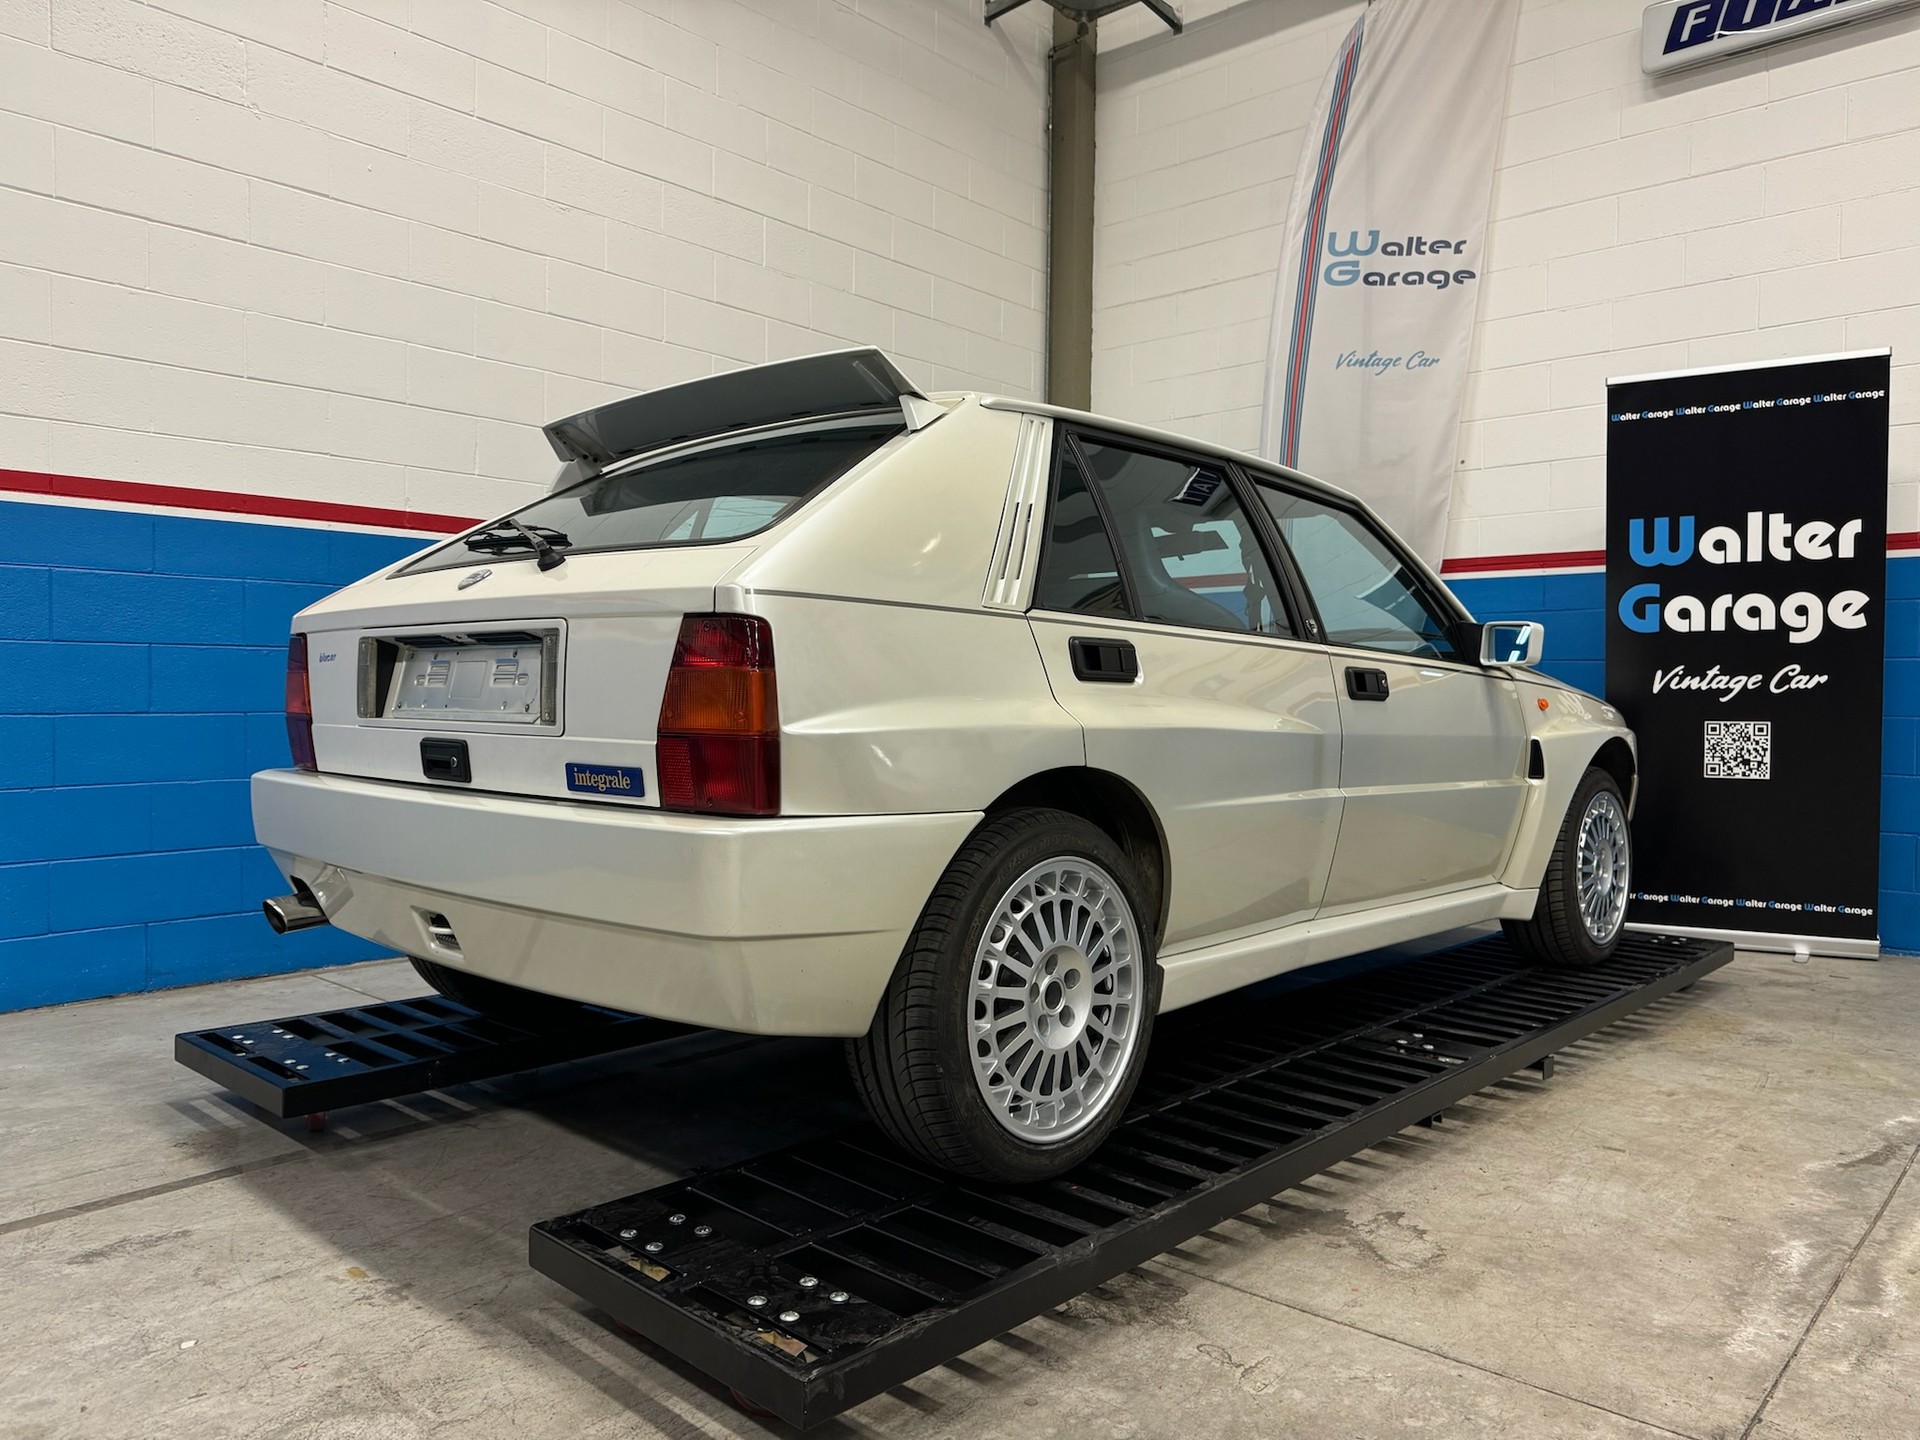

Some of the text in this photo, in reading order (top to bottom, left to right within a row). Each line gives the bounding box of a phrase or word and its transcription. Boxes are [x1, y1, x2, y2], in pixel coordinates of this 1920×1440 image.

[1679, 0, 1823, 43] FI
[1327, 229, 1467, 257] Walter
[1323, 260, 1476, 290] Garage
[1335, 350, 1440, 376] Vintage Car
[1611, 389, 1885, 422] Walter Garage Walter Garage Walter Garage Walter Garage
[1628, 511, 1863, 568] Walter
[1617, 583, 1870, 644] Garage
[1652, 664, 1828, 703] Vintage Car
[573, 767, 631, 792] integrale
[1637, 891, 1669, 902] Garage
[1670, 893, 1700, 904] Walter
[1701, 896, 1734, 907] Garage
[1735, 898, 1767, 908] Walter
[1768, 900, 1802, 911] Garage
[1804, 903, 1837, 913] Walter
[1838, 905, 1873, 916] Garage
